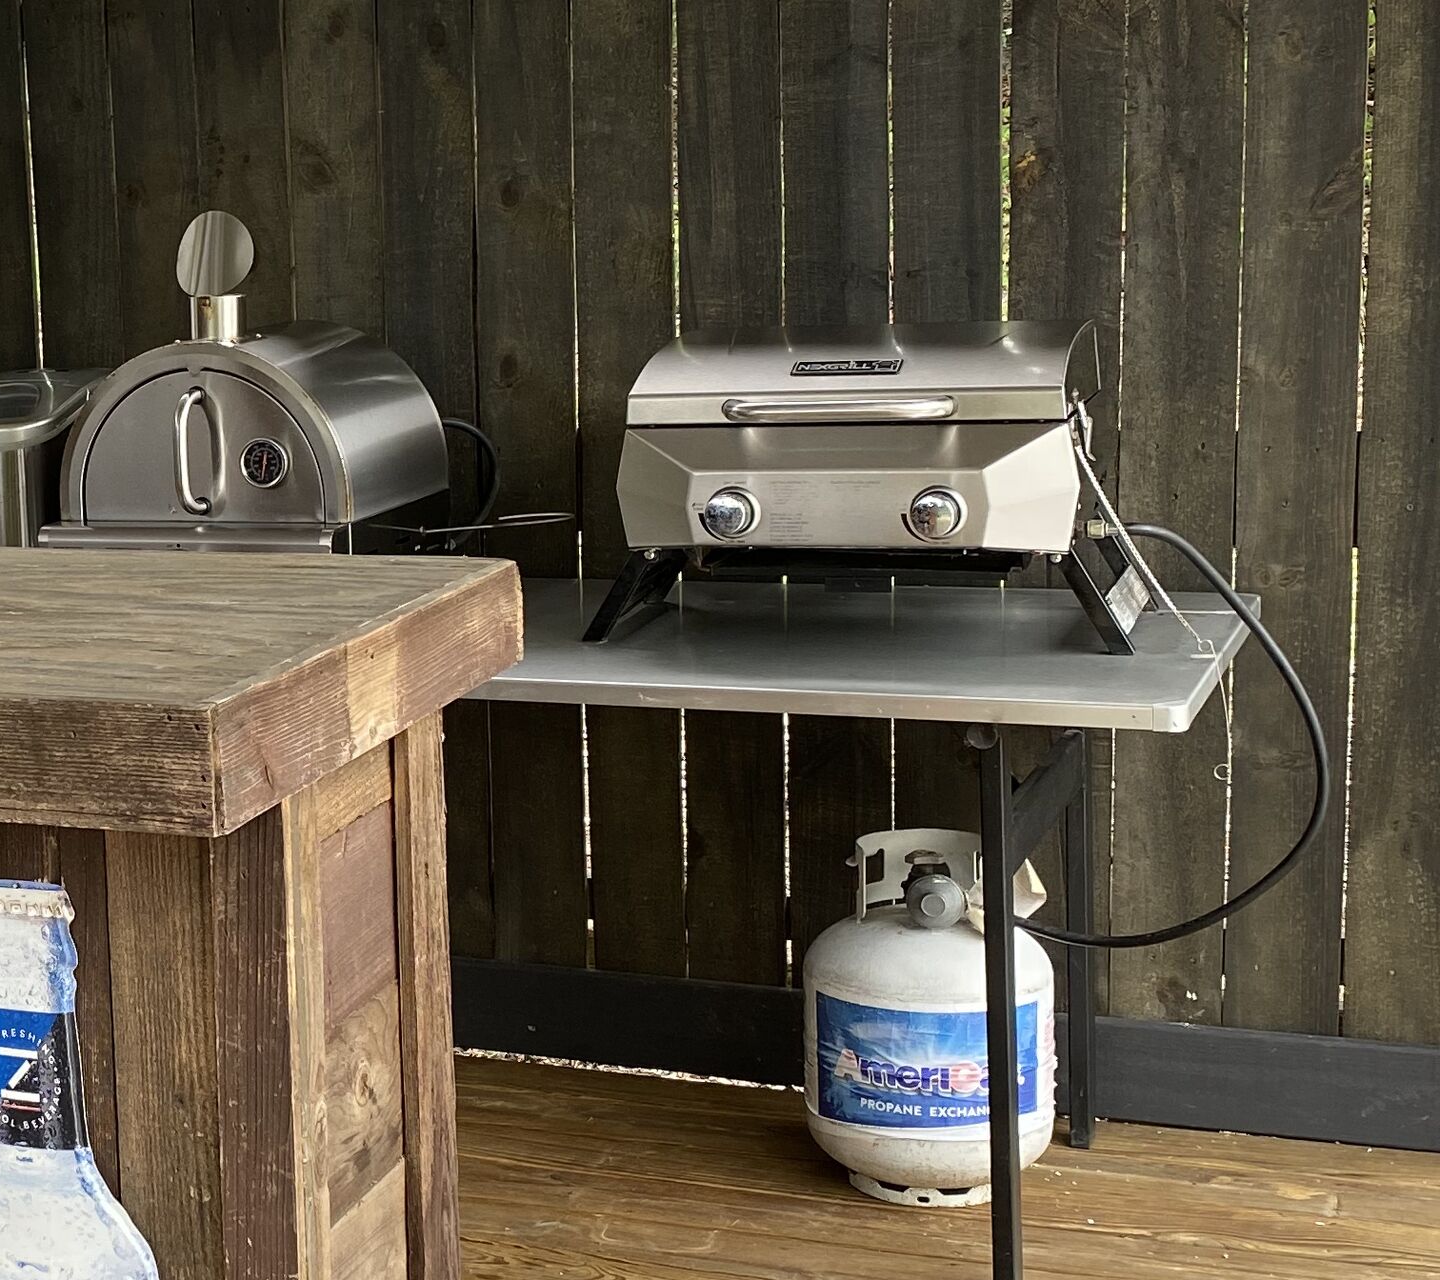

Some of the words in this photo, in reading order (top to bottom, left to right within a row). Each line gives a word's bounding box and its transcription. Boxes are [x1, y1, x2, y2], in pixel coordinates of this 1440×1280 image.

[797, 361, 872, 371] NEXGRILL
[834, 1048, 990, 1094] AmeriG
[22, 1078, 61, 1130] BEVERAGE
[860, 1097, 923, 1116] PROPANE
[929, 1105, 990, 1118] EXCHAN
